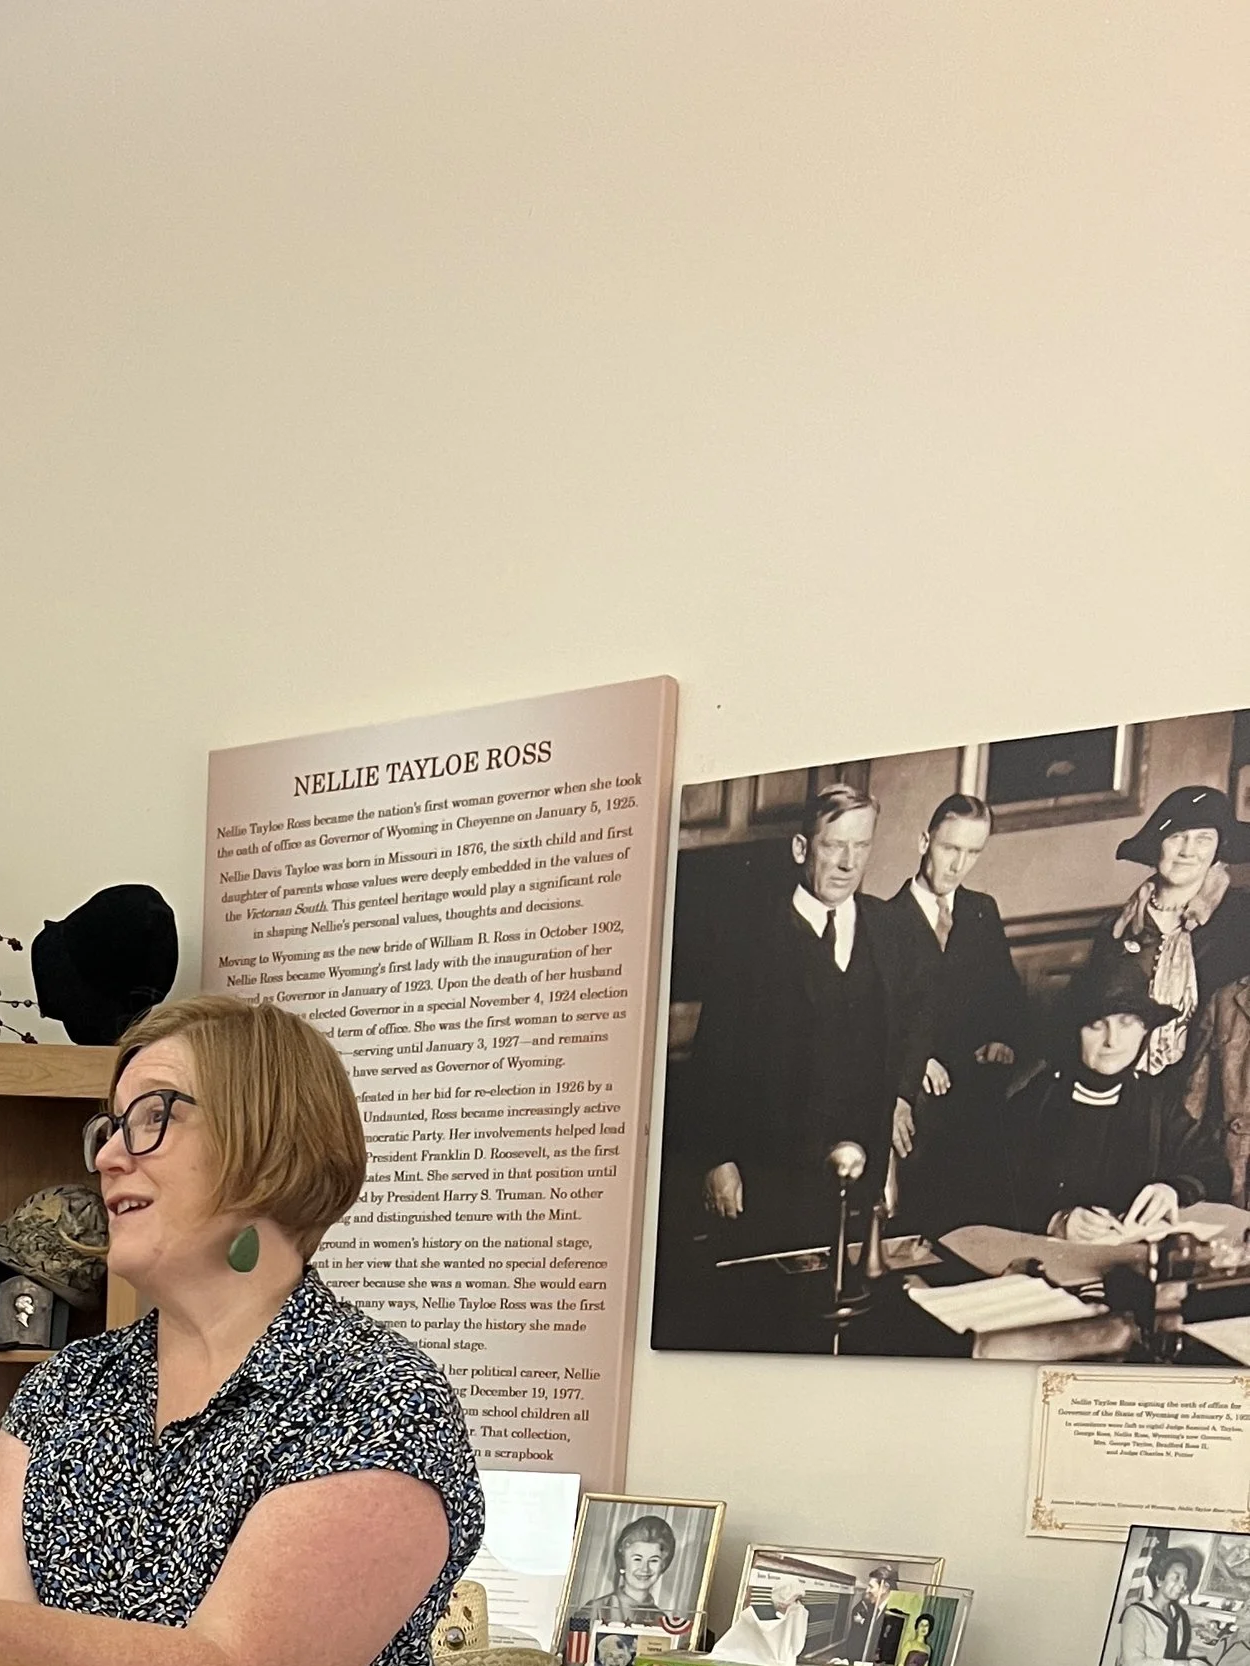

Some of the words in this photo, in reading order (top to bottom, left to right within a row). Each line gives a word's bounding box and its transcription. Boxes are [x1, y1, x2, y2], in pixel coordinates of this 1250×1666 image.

[293, 765, 379, 797] NELLIE
[386, 750, 479, 784] TAYLOE
[485, 740, 551, 771] ROSS
[216, 825, 247, 840] Nellie
[249, 820, 284, 836] Tayloe
[286, 817, 311, 830] Ross
[313, 814, 354, 826] became
[357, 808, 375, 821] the
[378, 801, 422, 818] nation's
[424, 798, 449, 813] first
[451, 795, 494, 808] woman
[497, 787, 551, 806] governor
[553, 781, 587, 795] when
[589, 777, 612, 791] she
[615, 772, 642, 788] took
[217, 847, 234, 858] the
[236, 843, 259, 856] oath
[261, 840, 273, 853] of
[274, 838, 302, 852] office
[304, 839, 317, 848] as
[319, 832, 371, 846] Governor
[372, 827, 385, 840] of
[386, 822, 440, 840] Wyoming
[441, 819, 453, 832] in
[456, 814, 515, 830] Cheyenne
[517, 812, 532, 822] on
[535, 805, 587, 820] January
[590, 800, 601, 815] 5,
[606, 796, 639, 811] 1925.
[220, 871, 250, 884] Nellie
[252, 868, 282, 880] Davis
[284, 862, 320, 878] Tayloe
[322, 862, 343, 871] was
[346, 857, 371, 869] born
[373, 854, 385, 866] in
[388, 847, 438, 865] Missouri
[440, 847, 453, 859] in
[456, 841, 487, 857] 1876,
[490, 839, 510, 853] the
[512, 834, 543, 850] sixth
[545, 830, 576, 847] child
[579, 827, 603, 843] and
[606, 825, 634, 840] first
[221, 889, 268, 904] daughter
[270, 885, 282, 898] of
[282, 883, 323, 900] parents
[326, 879, 359, 892] whose
[362, 874, 398, 888] values
[400, 873, 429, 883] were
[430, 865, 469, 882] deeply
[471, 857, 531, 876] embedded
[534, 857, 547, 870] in
[550, 854, 571, 867] the
[574, 850, 614, 865] values
[616, 846, 630, 860] of
[225, 910, 242, 922] the
[247, 908, 292, 920] Victorian
[330, 898, 356, 911] This
[358, 892, 398, 911] genteel
[401, 890, 449, 904] heritage
[452, 883, 487, 899] would
[489, 881, 516, 898] play
[518, 883, 526, 892] a
[529, 873, 595, 893] significant
[597, 871, 622, 884] role
[253, 931, 264, 939] in
[266, 925, 309, 939] shaping
[310, 918, 350, 934] Nellie's
[352, 913, 399, 933] personal
[402, 911, 442, 924] values,
[445, 904, 497, 921] thoughts
[499, 900, 523, 915] and
[525, 897, 584, 913] decisions.
[226, 974, 257, 987] Nellie
[260, 972, 283, 984] Ross
[286, 970, 326, 982] became
[328, 962, 386, 981] Wyoming's
[388, 961, 412, 974] first
[414, 957, 440, 973] lady
[442, 955, 469, 969] with
[472, 953, 492, 966] the
[493, 947, 573, 965] inauguration
[575, 944, 590, 958] of
[590, 943, 613, 956] her
[364, 1110, 428, 1124] Undaunted,
[430, 1108, 458, 1121] Ross
[460, 1107, 504, 1119] became
[507, 1102, 581, 1118] increasingly
[583, 1101, 621, 1114] active
[420, 1148, 471, 1162] Franklin
[473, 1147, 487, 1160] D.
[490, 1146, 550, 1160] Roosevelt,
[553, 1149, 568, 1157] as
[571, 1145, 591, 1157] the
[593, 1144, 620, 1157] first
[353, 1211, 374, 1223] and
[376, 1210, 452, 1225] distinguished
[455, 1211, 493, 1222] tenure
[496, 1209, 523, 1222] with
[526, 1209, 546, 1221] the
[548, 1208, 582, 1221] Mint.
[326, 1279, 361, 1289] career
[362, 1276, 406, 1288] because
[407, 1276, 427, 1289] she
[430, 1280, 452, 1289] was
[454, 1281, 462, 1289] a
[465, 1281, 511, 1289] woman.
[513, 1276, 537, 1290] She
[539, 1277, 576, 1290] would
[578, 1282, 607, 1291] earn
[449, 1365, 468, 1377] her
[470, 1364, 517, 1379] political
[519, 1369, 560, 1382] career,
[564, 1367, 602, 1381] Nellie
[470, 1384, 529, 1400] December
[531, 1387, 548, 1401] 19,
[553, 1388, 584, 1400] 1977.
